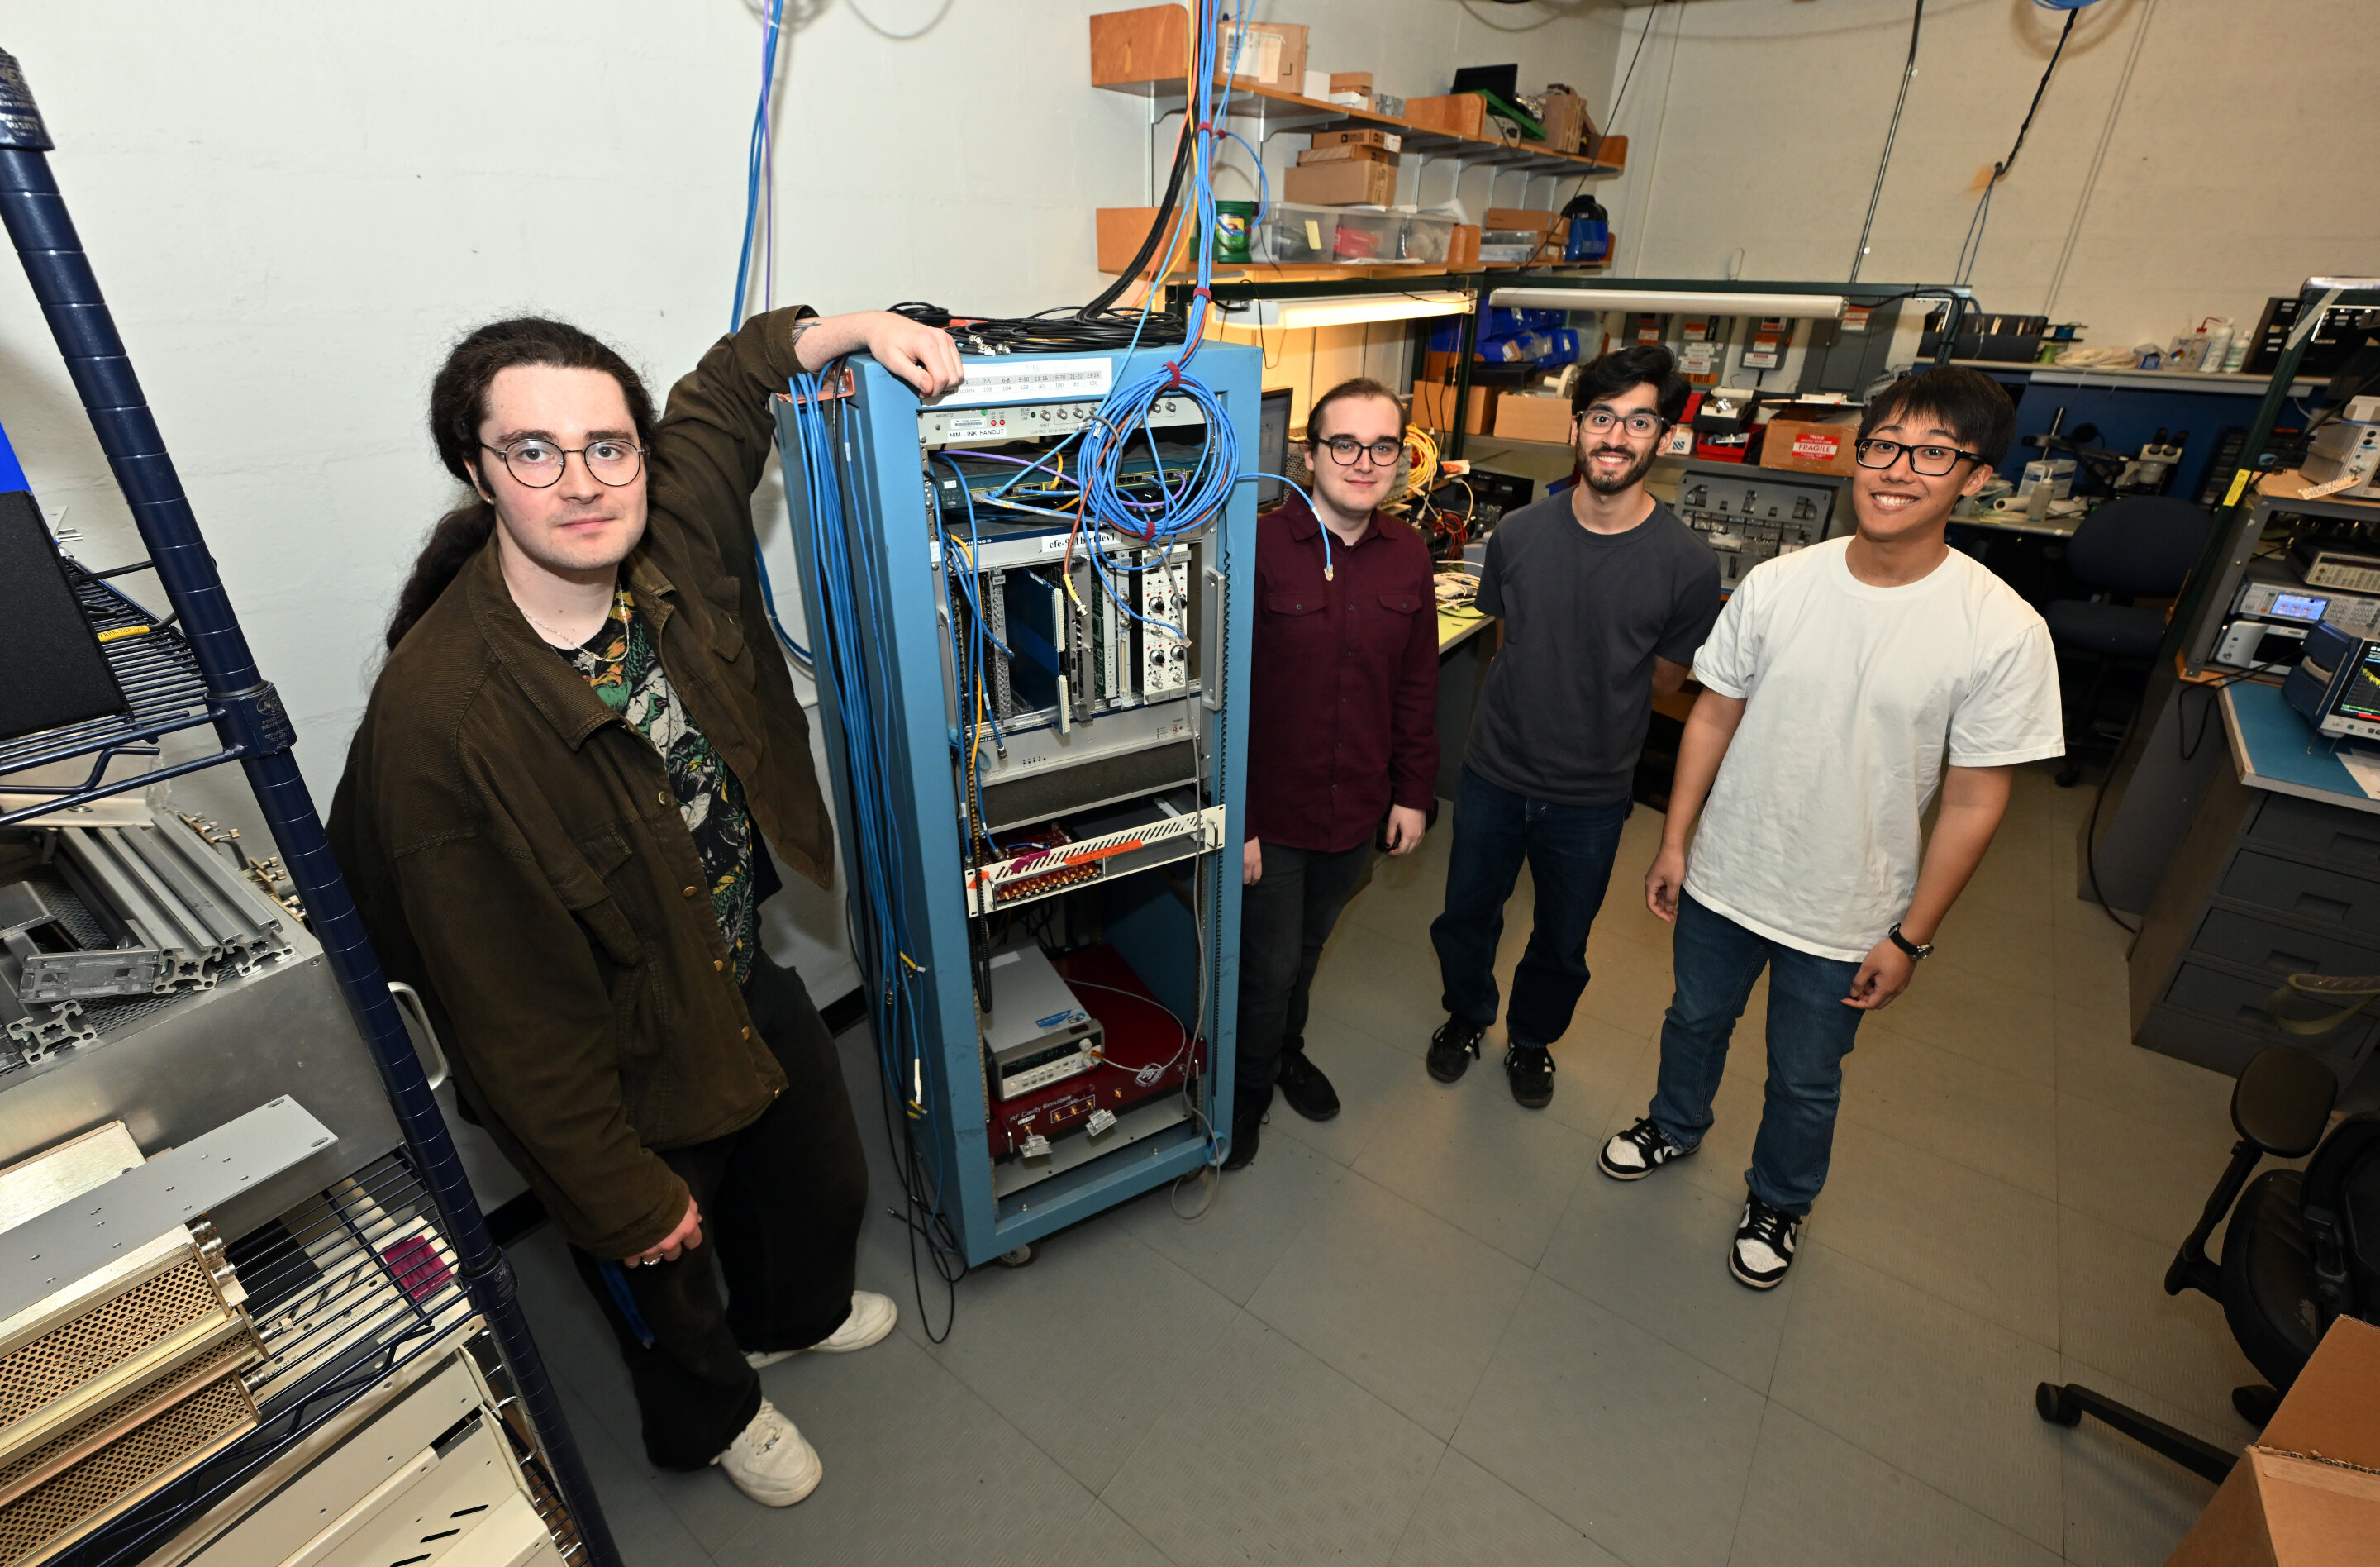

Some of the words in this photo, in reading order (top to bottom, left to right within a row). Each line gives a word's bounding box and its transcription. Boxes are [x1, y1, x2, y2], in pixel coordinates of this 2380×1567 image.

[1798, 443, 1831, 452] FRAGILE
[1010, 1114, 1020, 1122] RF
[1021, 1107, 1041, 1118] Cavity
[1043, 1095, 1073, 1109] Simulator
[340, 1320, 350, 1328] OUT
[271, 1366, 282, 1374] OUT
